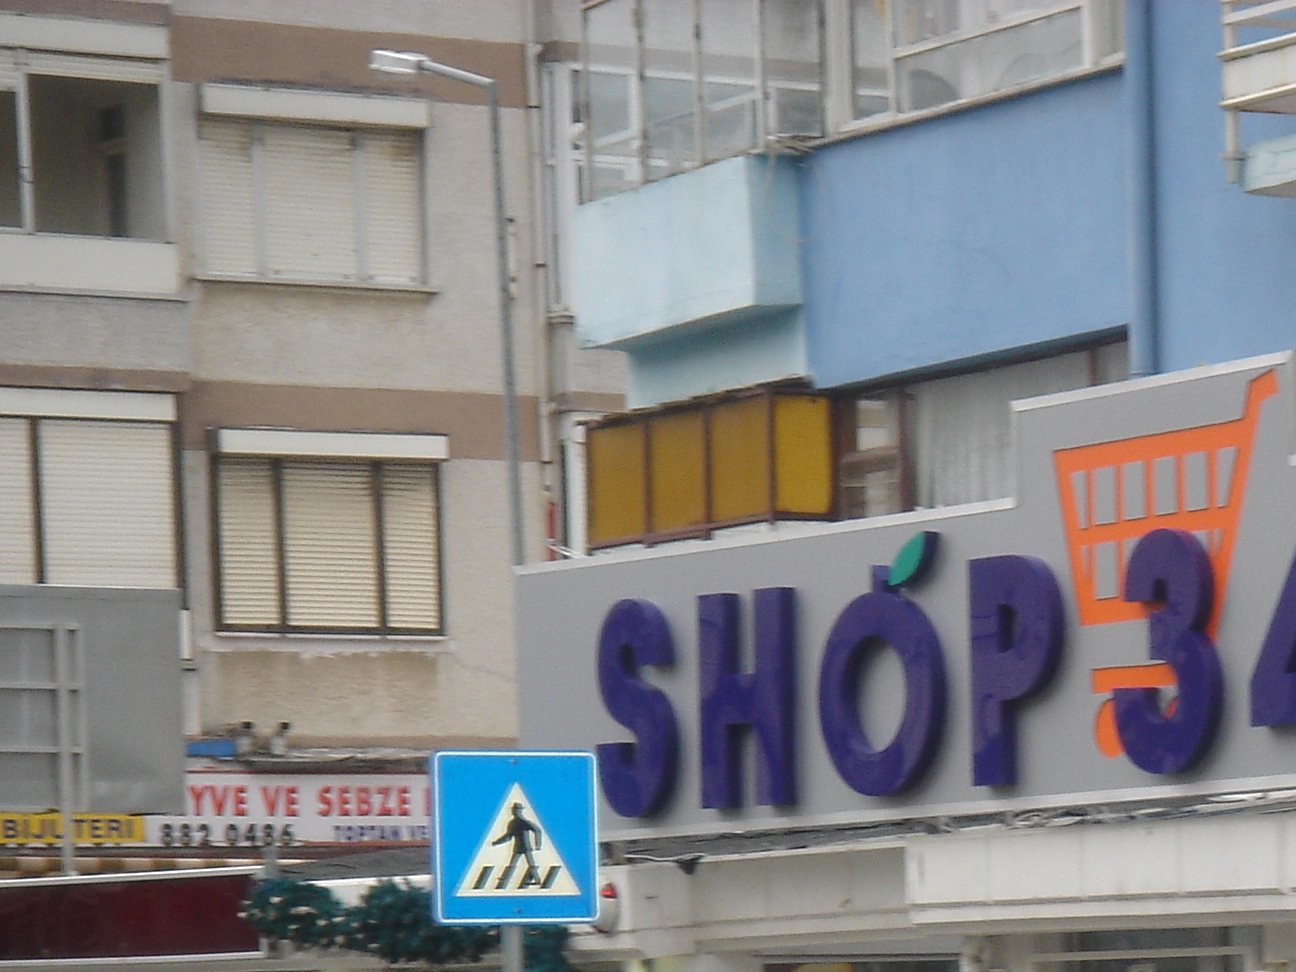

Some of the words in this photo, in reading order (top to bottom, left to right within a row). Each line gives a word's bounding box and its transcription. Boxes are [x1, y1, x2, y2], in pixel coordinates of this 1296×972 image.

[595, 552, 1064, 819] SHOP
[260, 785, 299, 816] VE
[317, 785, 410, 816] SEBZE
